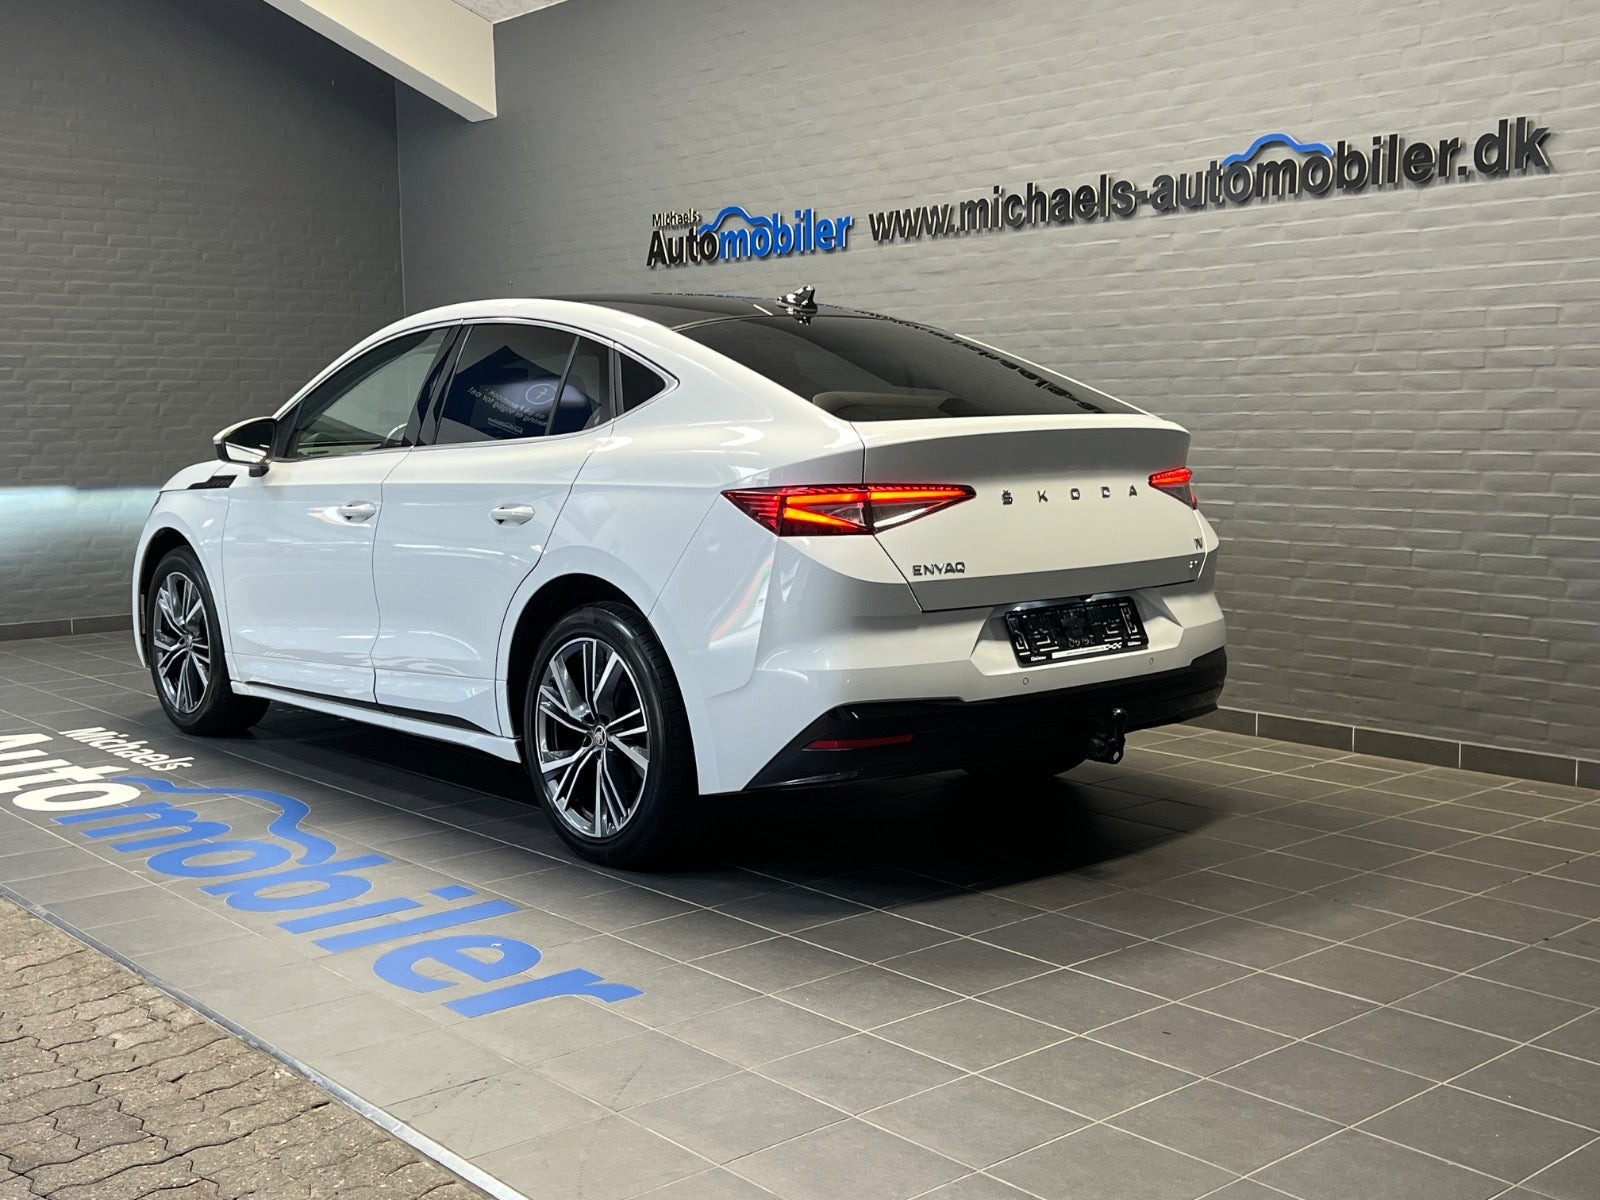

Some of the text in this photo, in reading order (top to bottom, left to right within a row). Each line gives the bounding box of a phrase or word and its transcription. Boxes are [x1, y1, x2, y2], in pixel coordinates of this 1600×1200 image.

[868, 116, 1551, 242] www.michaels-automobiler.dk
[647, 208, 853, 267] Automobiler
[652, 207, 701, 229] Michaels
[912, 561, 966, 576] ENYAQ
[58, 726, 195, 771] Michaels
